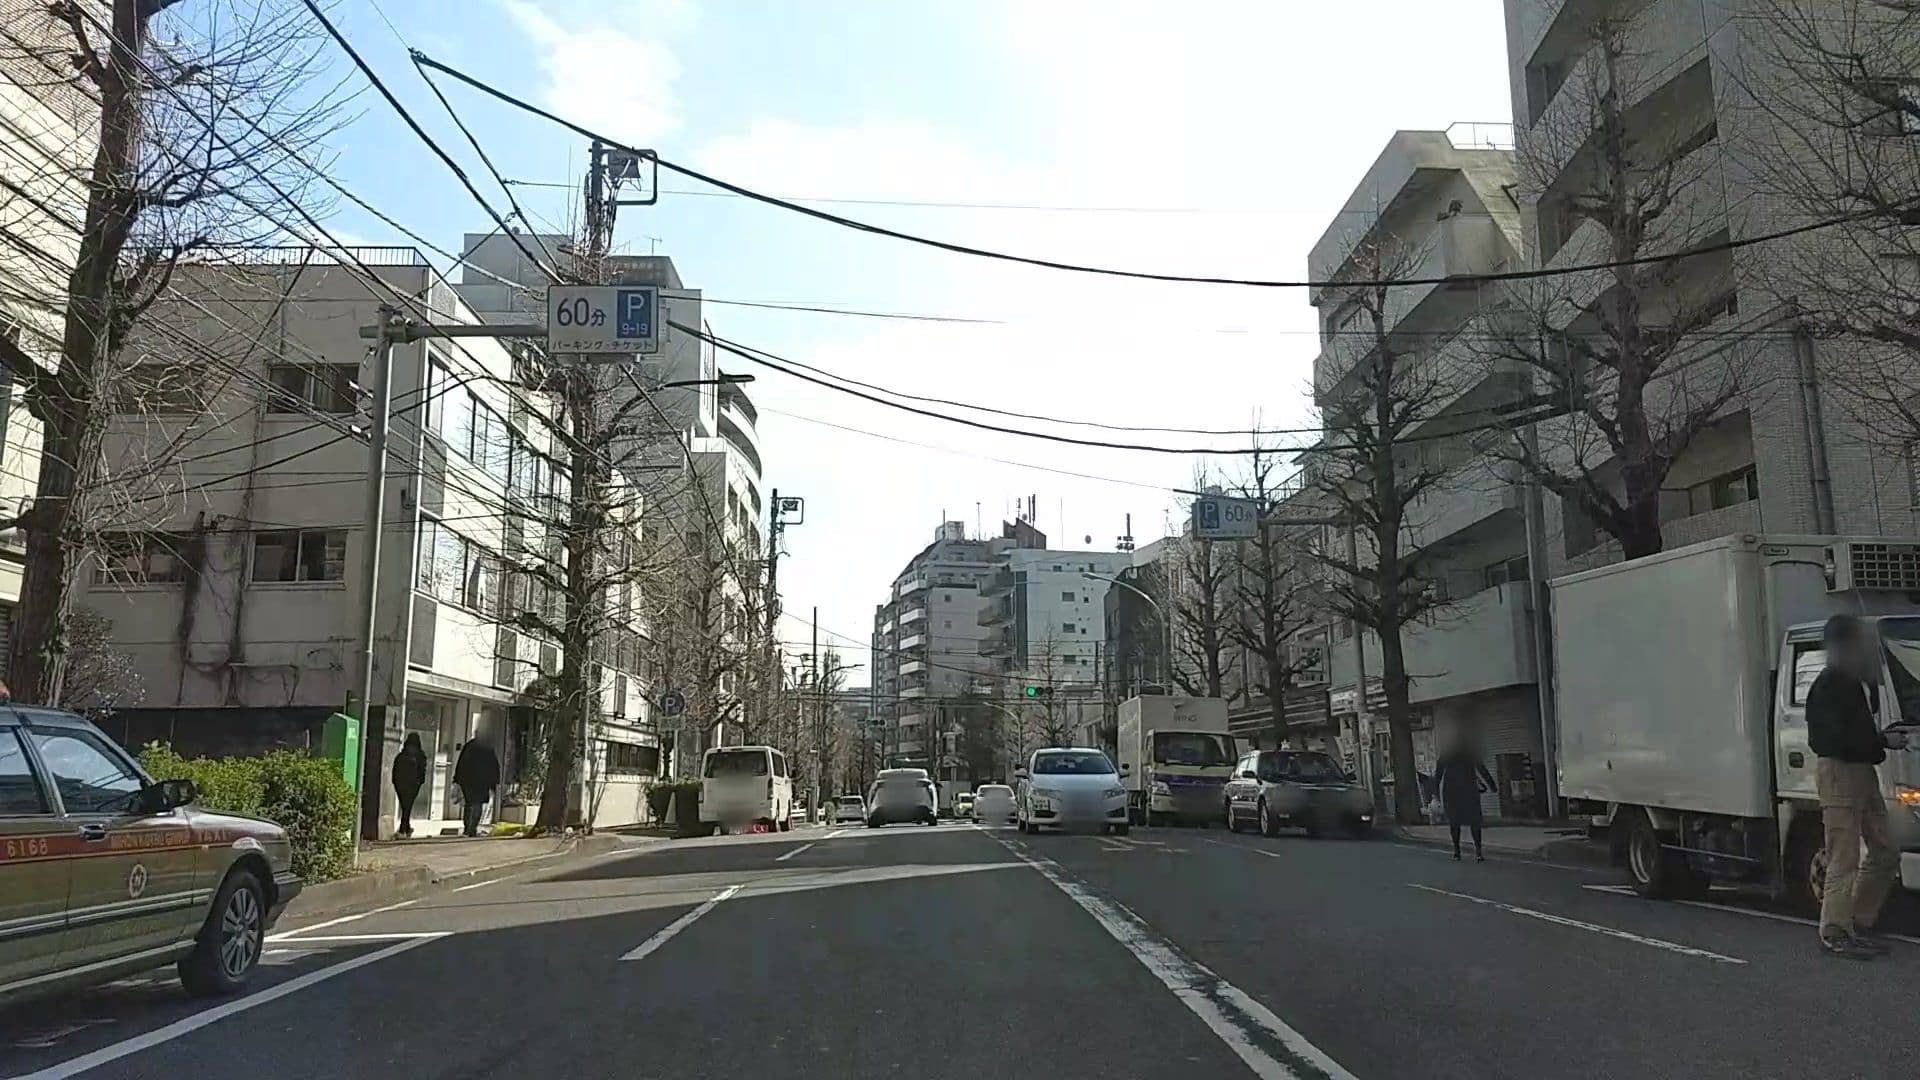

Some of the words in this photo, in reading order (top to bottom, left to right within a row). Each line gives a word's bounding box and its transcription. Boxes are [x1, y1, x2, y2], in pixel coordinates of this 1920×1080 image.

[557, 297, 607, 327] 60分
[627, 293, 645, 320] P
[1204, 503, 1216, 519] P
